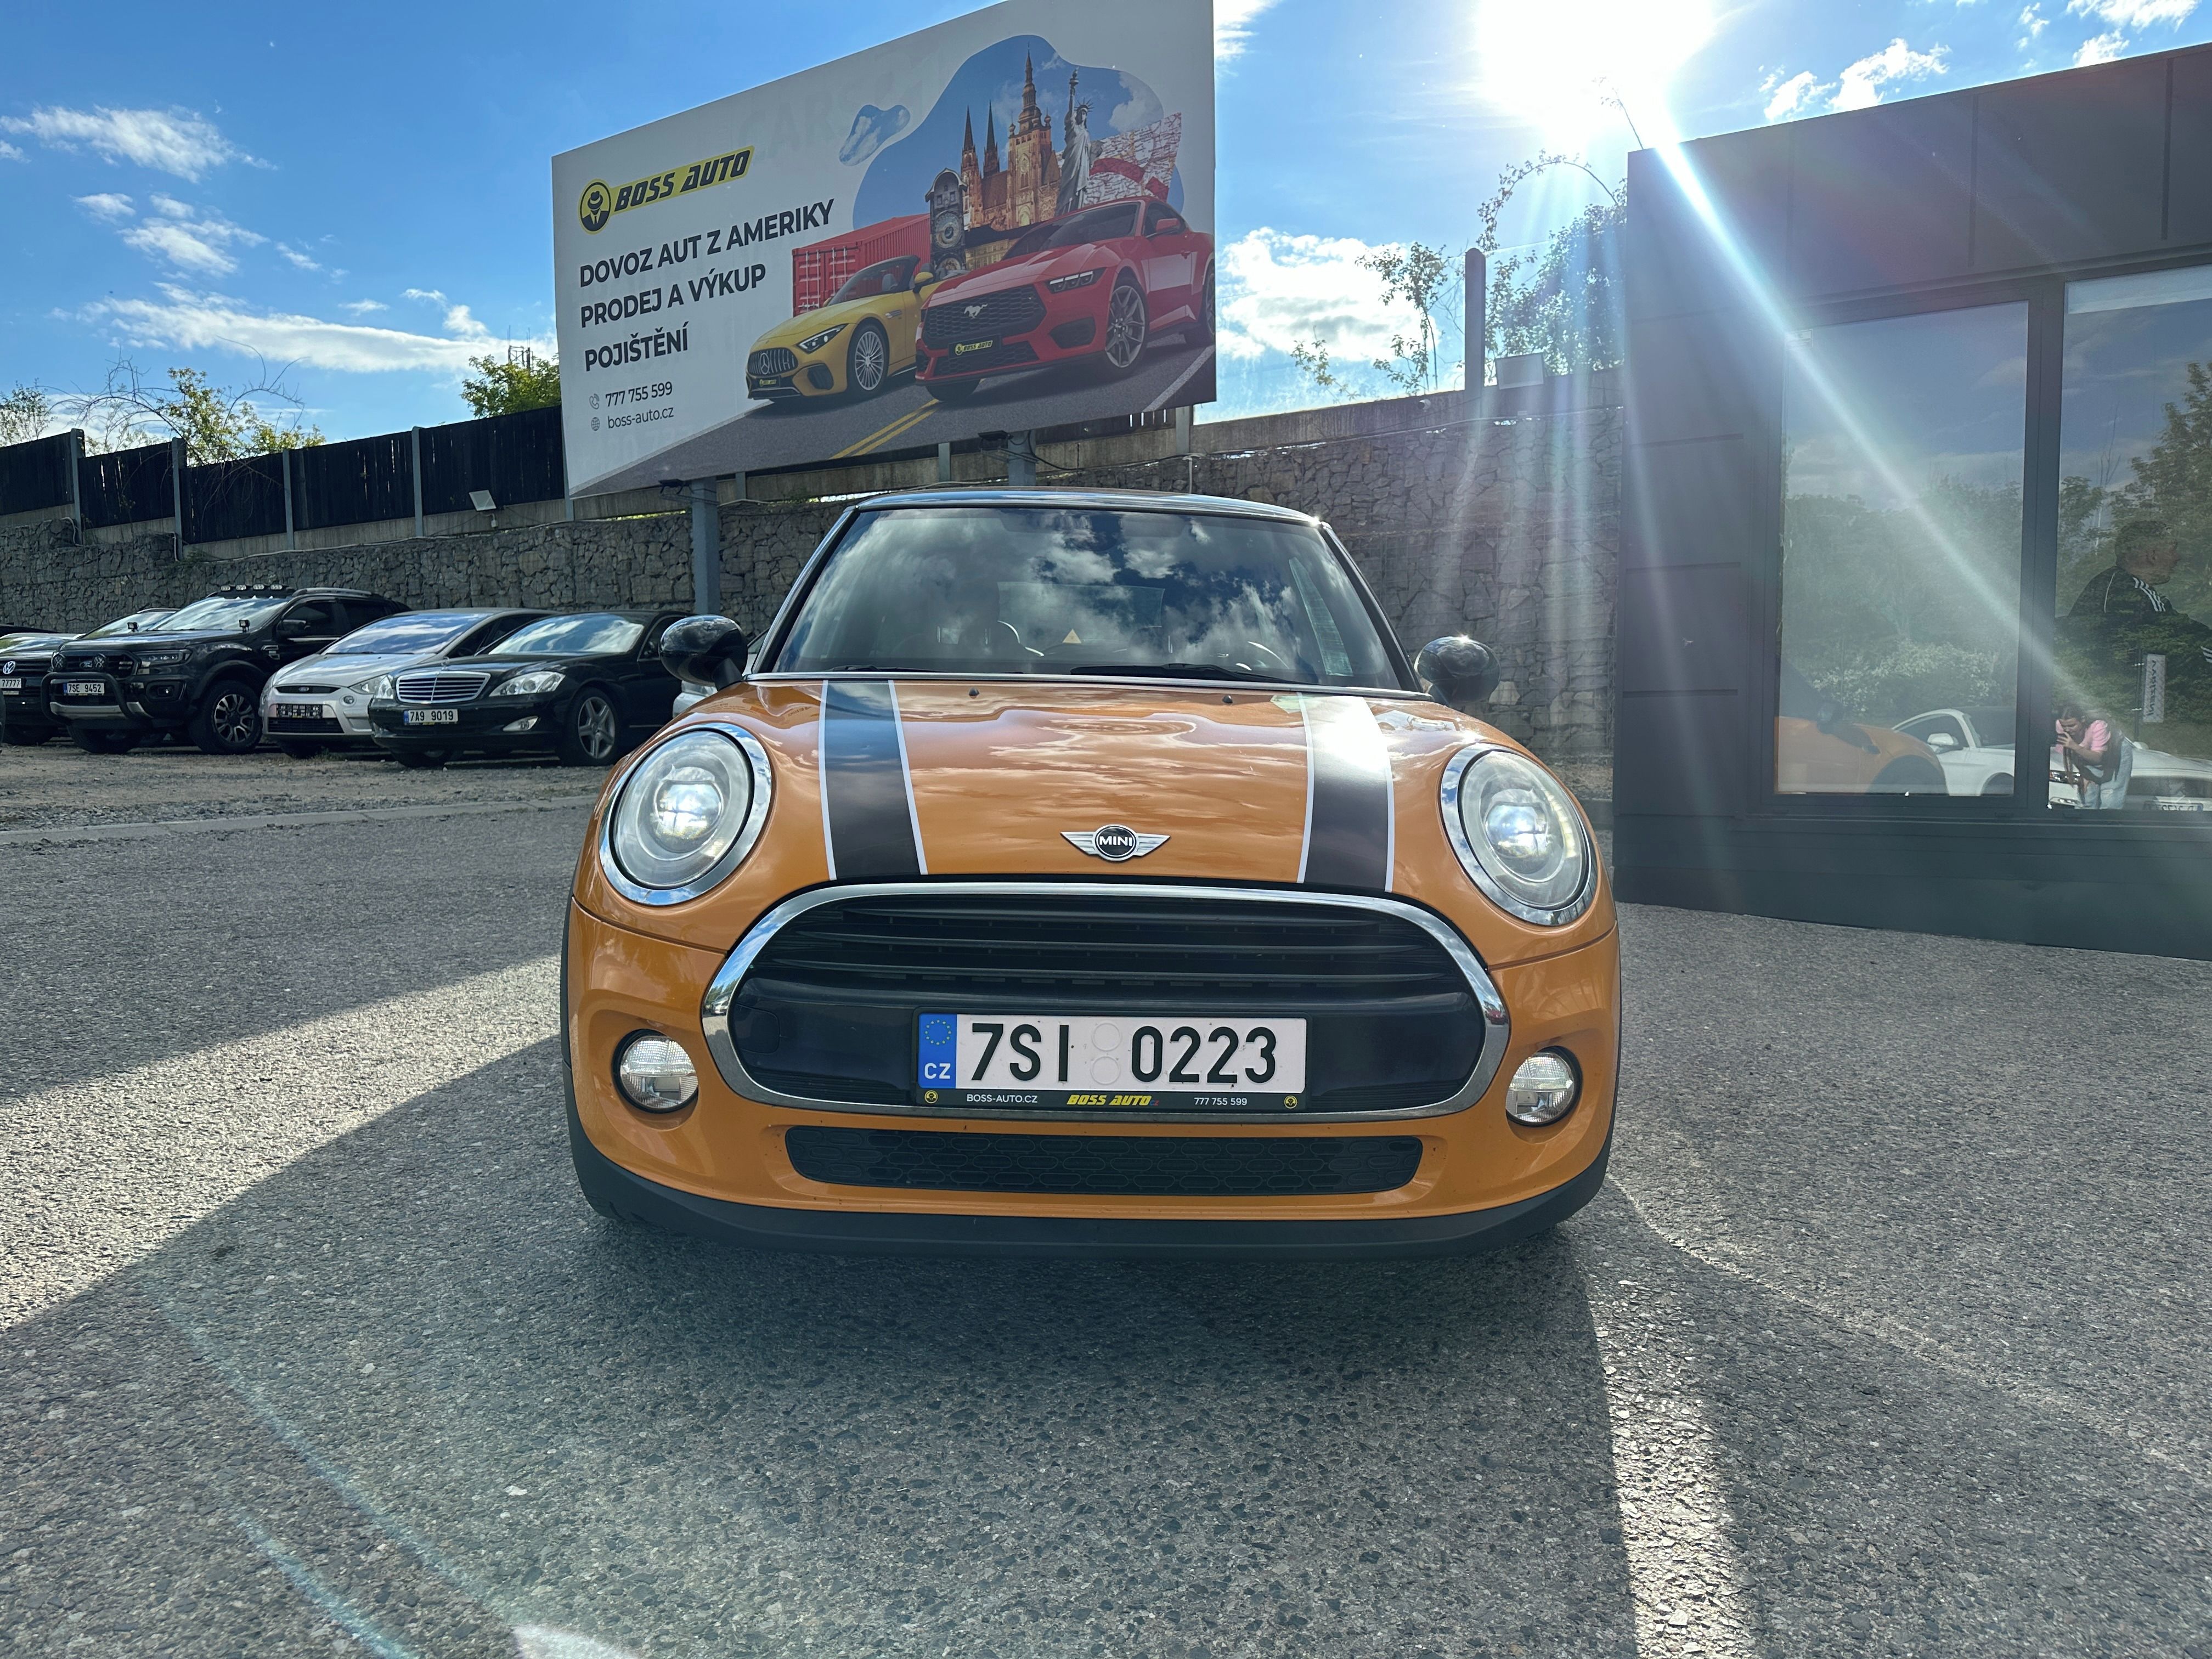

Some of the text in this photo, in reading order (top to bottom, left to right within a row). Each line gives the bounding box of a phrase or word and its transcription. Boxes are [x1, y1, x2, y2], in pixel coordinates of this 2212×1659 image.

[614, 150, 751, 212] BOSS AUTO
[580, 198, 834, 287] DOVOZ AUT Z AMERIKY
[581, 263, 766, 328] PRODEJ A VÝKUP
[585, 321, 689, 371] POJIŠTĚNÍ
[605, 381, 673, 407] 777 755 599
[607, 407, 674, 429] boss-auto.cz
[69, 684, 101, 693] 7SE 9452
[410, 710, 454, 721] 7A9 9019
[1099, 836, 1132, 847] MINI
[972, 1023, 1277, 1084] 7SI 0223
[924, 1063, 951, 1079] CZ
[967, 1094, 1038, 1103] BOSS-AUTO.CZ
[1066, 1094, 1107, 1105] BOSS
[1109, 1095, 1152, 1106] AUTO
[1194, 1097, 1248, 1106] 777 755 599
